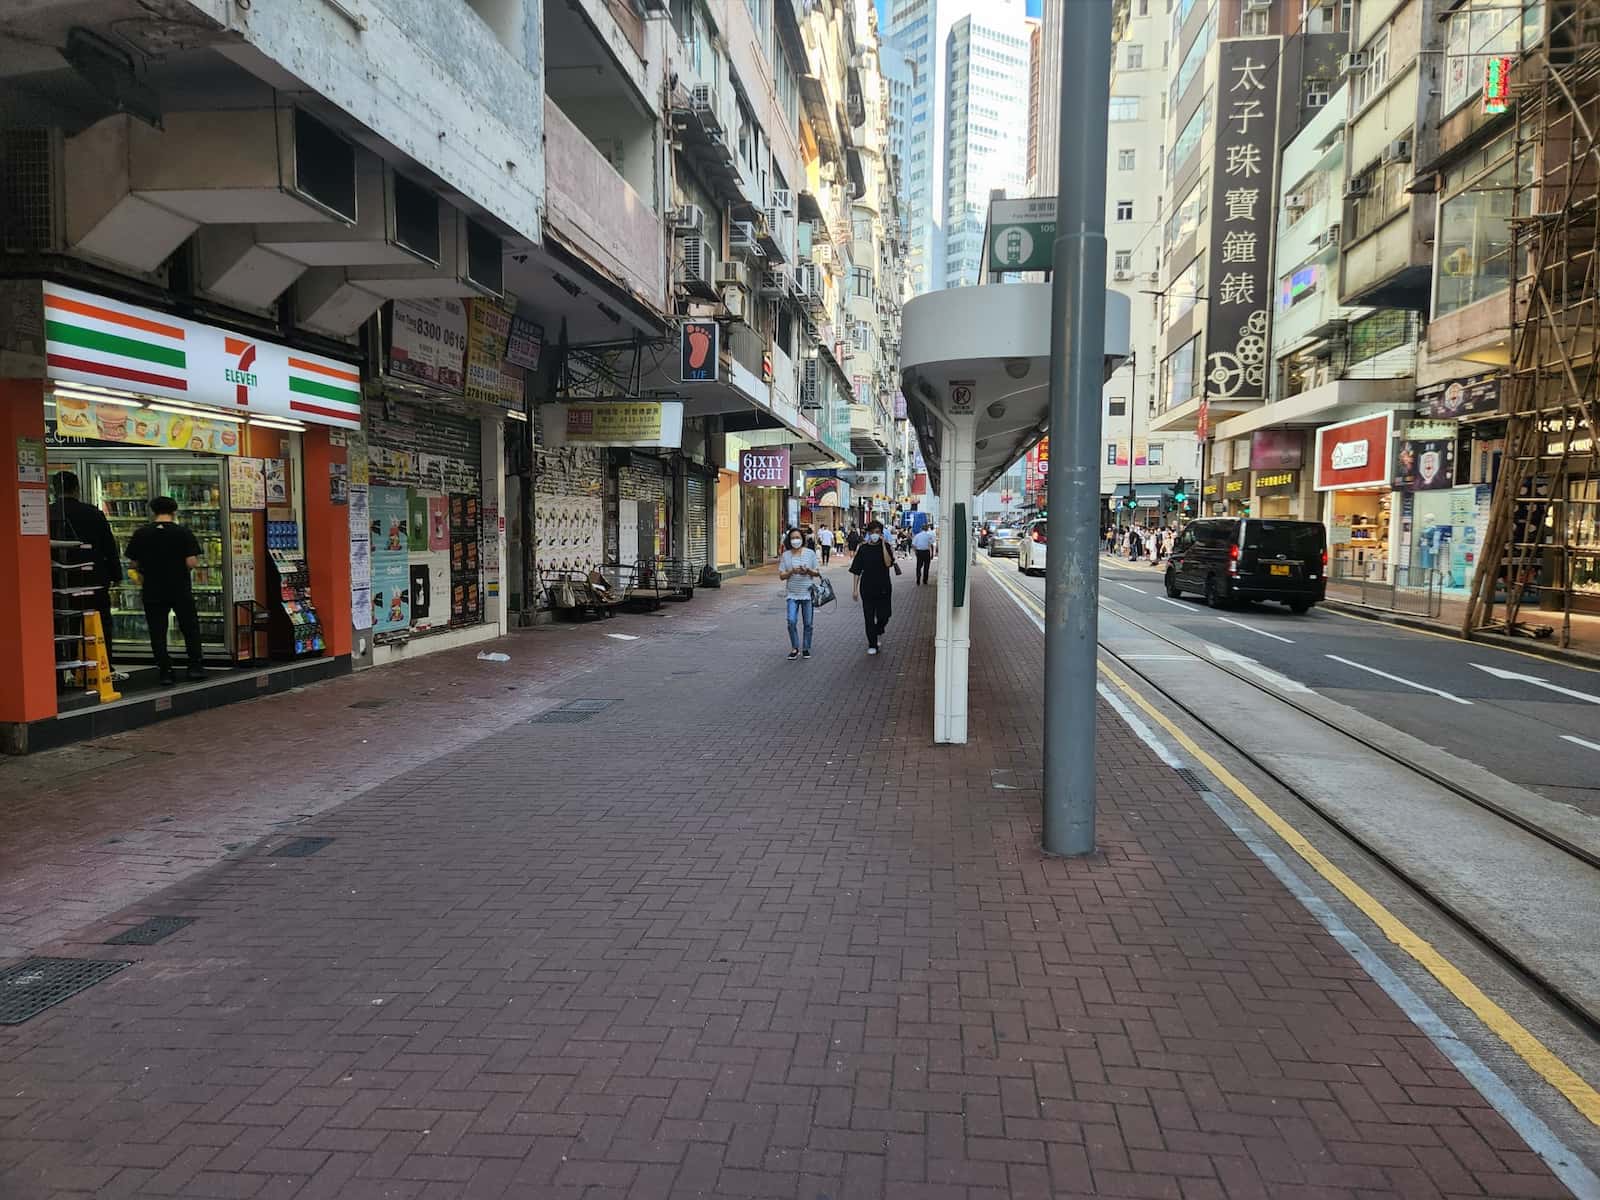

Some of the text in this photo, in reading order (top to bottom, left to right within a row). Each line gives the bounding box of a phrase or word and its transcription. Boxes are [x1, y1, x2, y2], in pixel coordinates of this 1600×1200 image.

[1219, 57, 1266, 305] 太子珠寶鐘錶
[416, 317, 441, 342] 8300
[443, 328, 465, 351] 0616
[225, 336, 256, 406] 7
[743, 453, 784, 468] 6IXTY
[743, 468, 784, 482] 8IGHT
